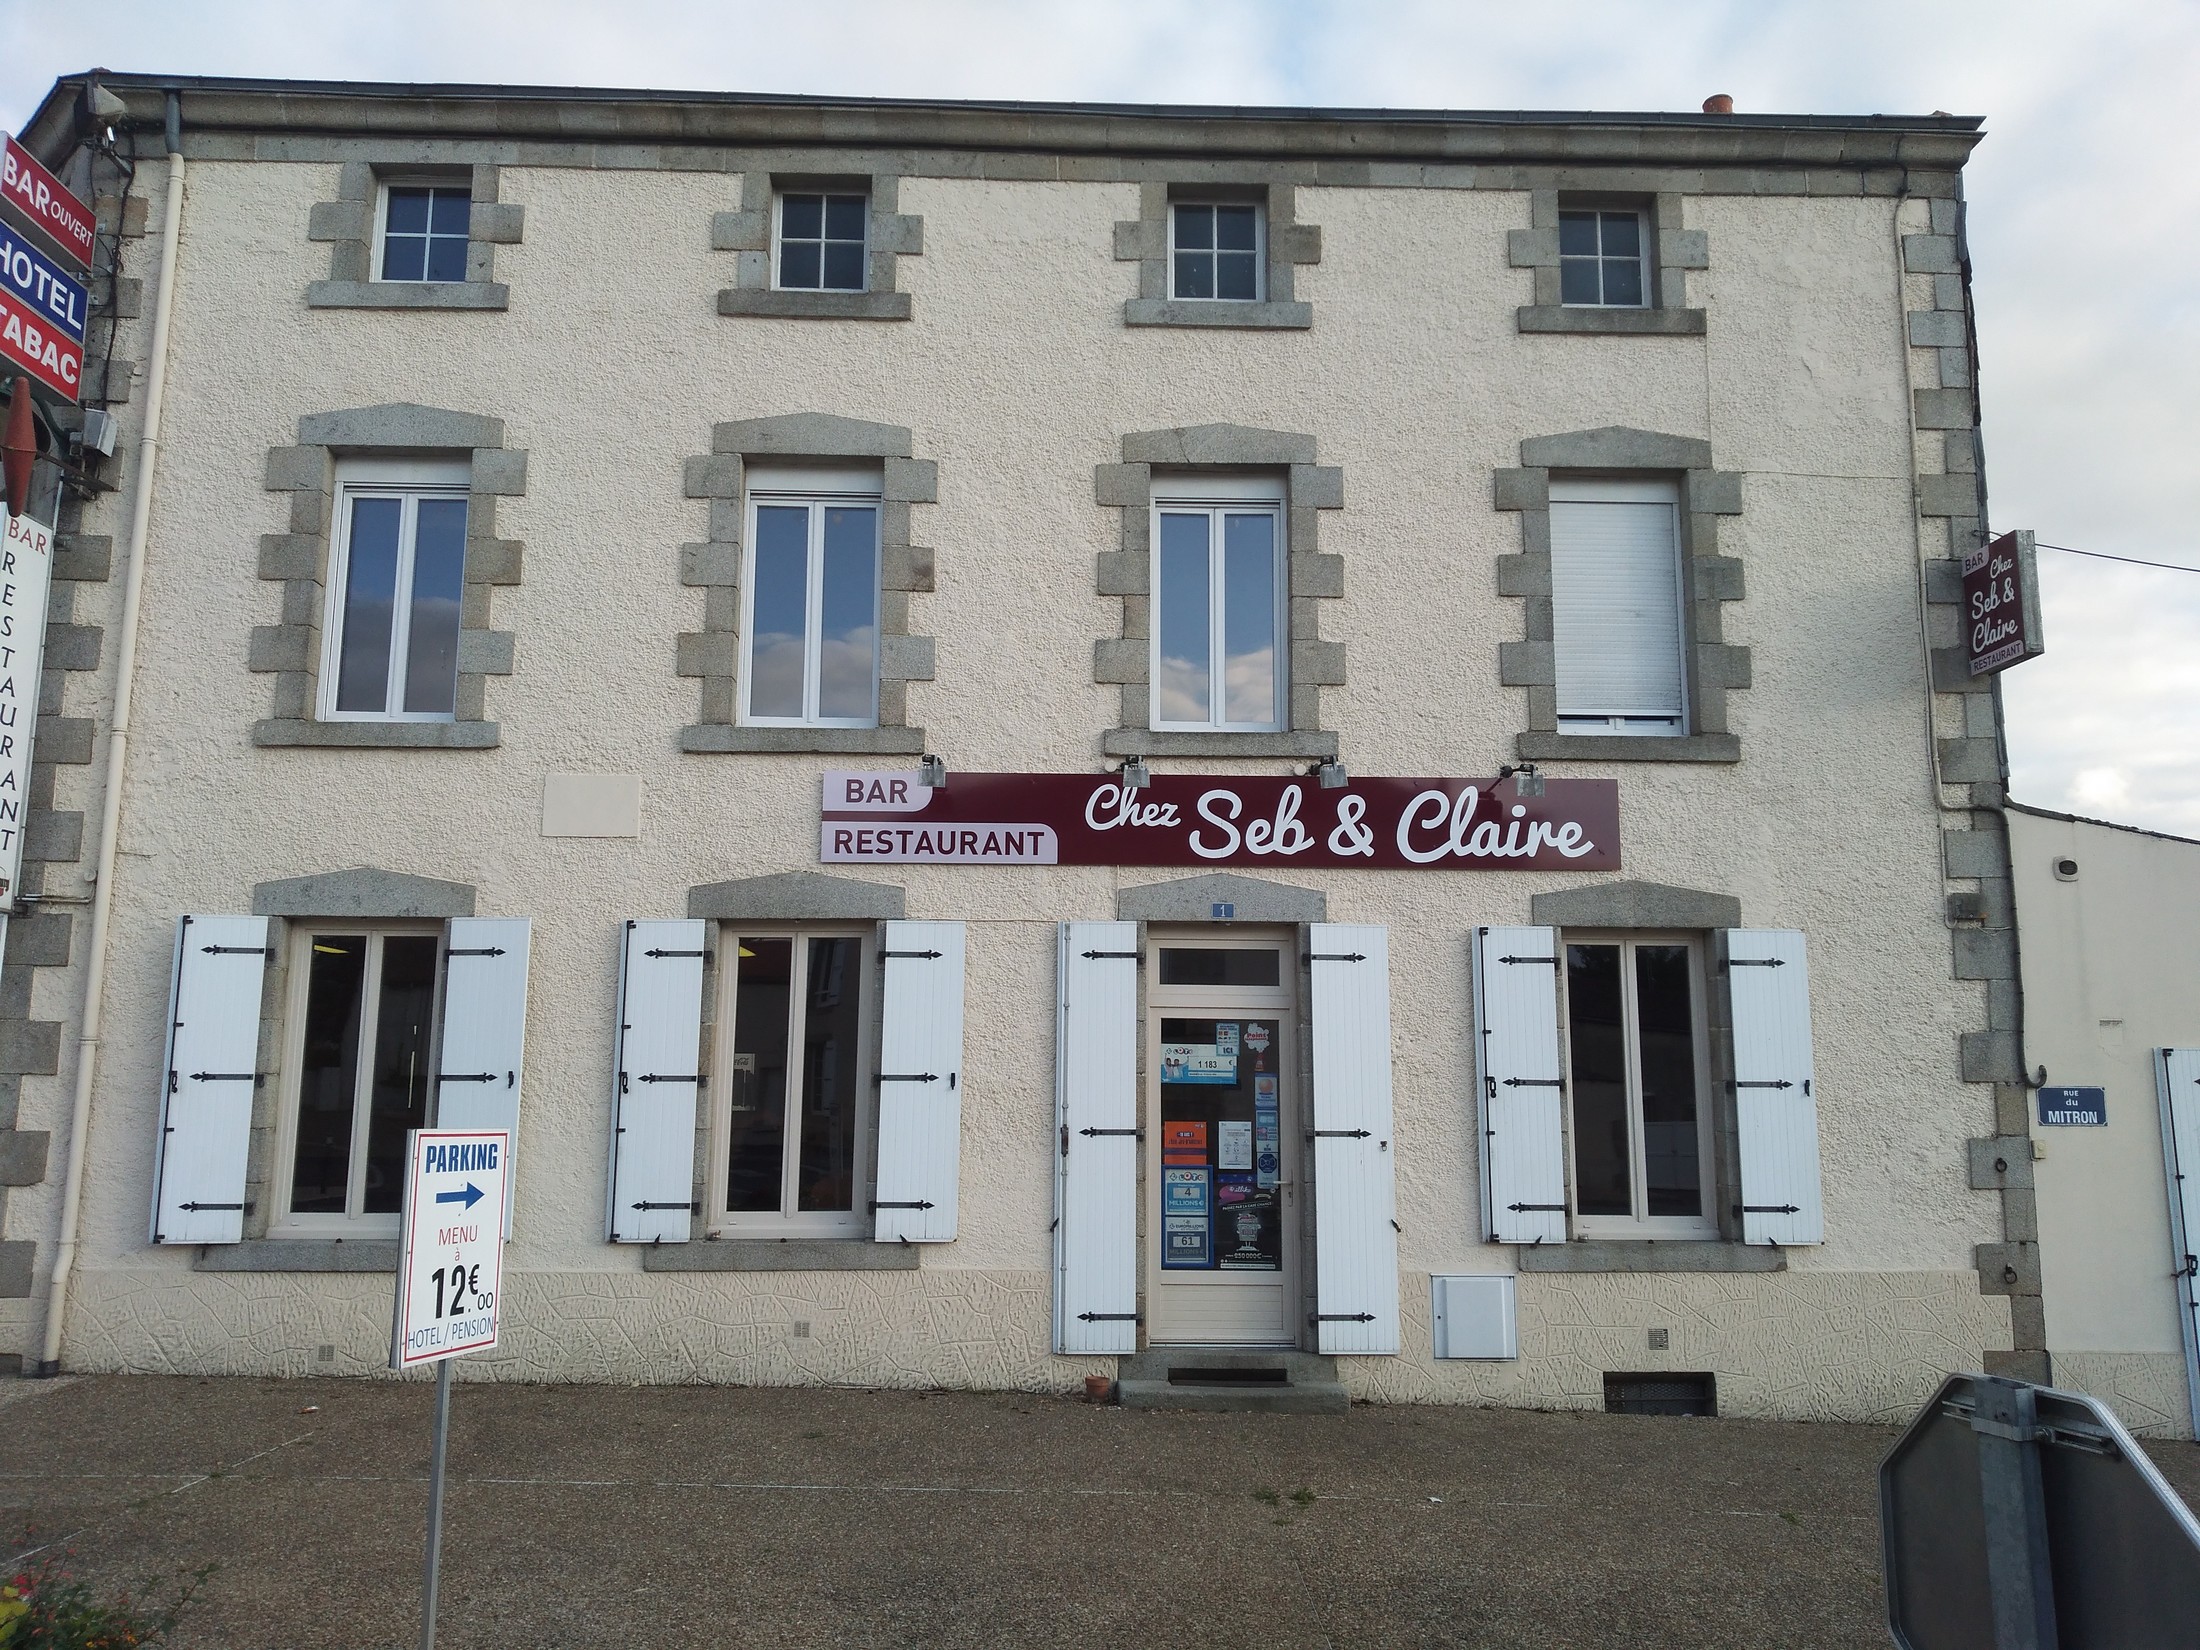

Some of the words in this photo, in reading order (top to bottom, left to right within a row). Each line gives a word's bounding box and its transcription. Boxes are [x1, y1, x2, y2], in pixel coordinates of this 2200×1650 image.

[4, 152, 48, 217] BAR
[51, 201, 93, 248] OUVERT
[8, 517, 47, 556] BAR
[1965, 552, 1984, 571] BAR
[1990, 555, 2013, 579] Chez
[1972, 580, 2001, 620] Seb
[2003, 576, 2015, 603] &
[1973, 617, 2018, 653] Claire
[1974, 643, 2021, 671] RESTAURANT
[0, 550, 18, 851] RESTAURANT
[845, 779, 908, 804] BAR
[1084, 784, 1181, 831] Chez
[1188, 785, 1315, 859] Seb
[1328, 794, 1375, 858] &
[1397, 785, 1595, 863] Claire
[834, 830, 1045, 856] RESTAURANT
[1220, 904, 1226, 917] 1
[1205, 1060, 1217, 1069] 183
[2048, 1110, 2098, 1123] MITRON
[425, 1143, 498, 1173] PARKING
[1184, 1187, 1191, 1197] 4
[438, 1225, 478, 1246] MENU
[1181, 1236, 1194, 1246] 61
[454, 1248, 460, 1261] à
[408, 1327, 441, 1350] HOTEL
[452, 1316, 494, 1341] PENSION
